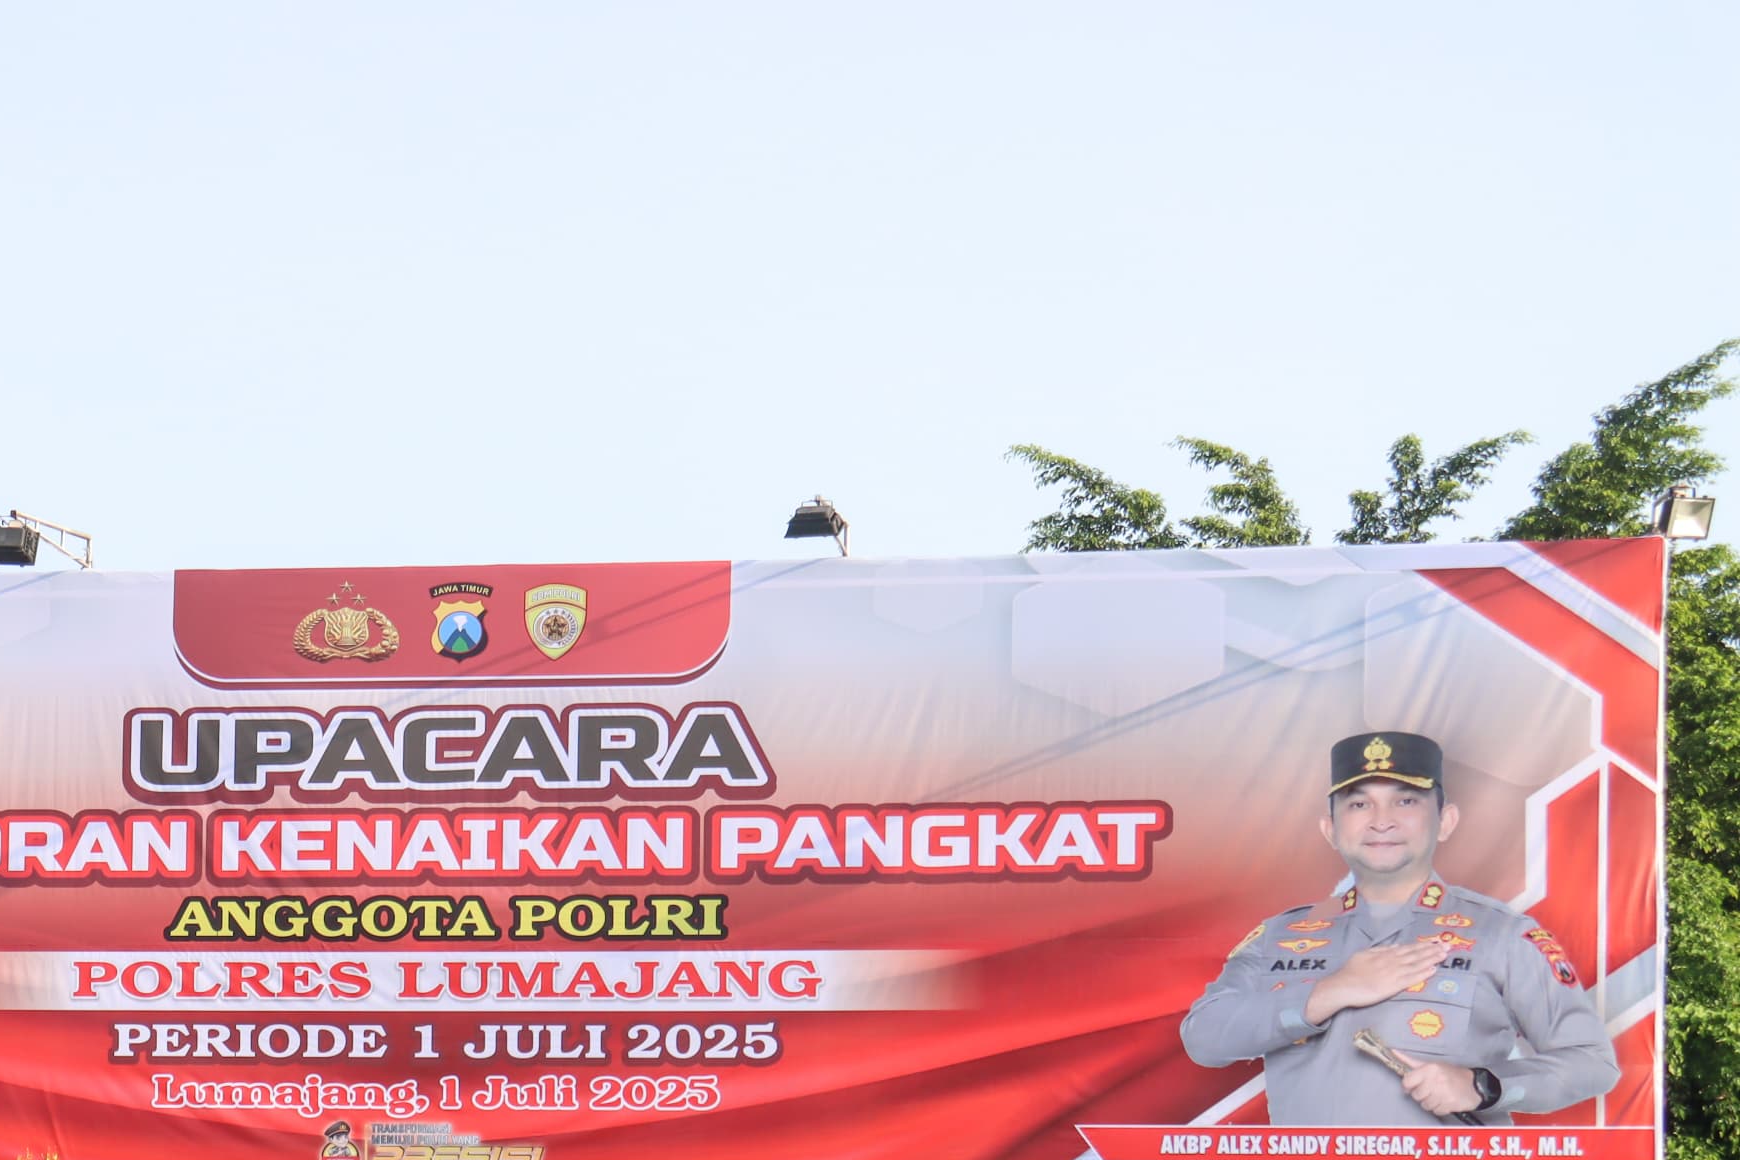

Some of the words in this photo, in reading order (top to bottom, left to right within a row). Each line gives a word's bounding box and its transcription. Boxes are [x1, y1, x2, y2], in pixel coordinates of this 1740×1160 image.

[432, 584, 459, 597] JAWA
[460, 583, 490, 597] TIMUR
[136, 711, 761, 787] UPACARA
[220, 817, 685, 872] KENAIKAN
[720, 812, 1157, 868] PANGKAT
[169, 899, 496, 938] ANGGOTA
[515, 898, 724, 937] POLRI
[73, 961, 372, 999] POLRES
[398, 960, 823, 999] LUMAJANG
[1270, 957, 1328, 973] ALEX
[112, 1023, 388, 1059] PERIODE
[413, 1023, 441, 1059] 1
[463, 1023, 609, 1059] JULI
[627, 1021, 779, 1059] 2025
[152, 1074, 429, 1117] Lumajang,
[440, 1075, 462, 1110] 1
[472, 1075, 579, 1111] Juli
[588, 1074, 720, 1111] 2025
[1160, 1134, 1213, 1155] AKBP
[1216, 1134, 1263, 1155] ALEX
[1267, 1134, 1330, 1156] SANDY
[1334, 1135, 1423, 1160] SIREGAR,
[1427, 1136, 1485, 1160] S.I.K.,
[1489, 1136, 1533, 1160] S.H.,
[1538, 1137, 1584, 1157] M.H.
